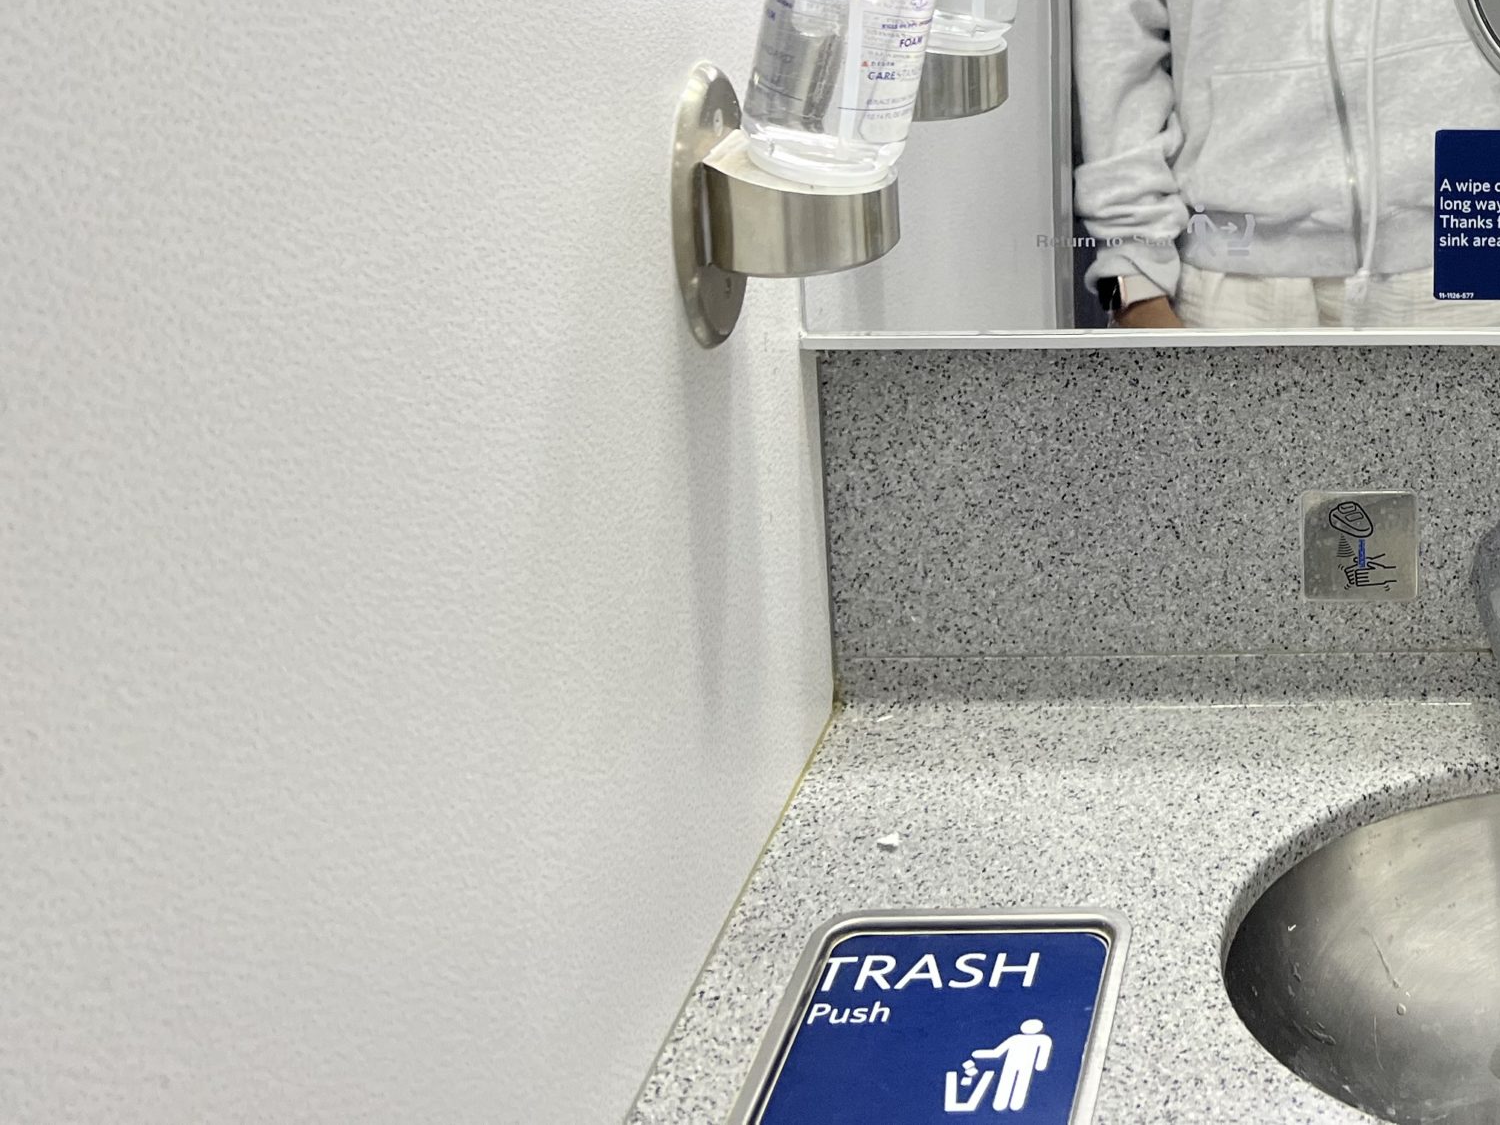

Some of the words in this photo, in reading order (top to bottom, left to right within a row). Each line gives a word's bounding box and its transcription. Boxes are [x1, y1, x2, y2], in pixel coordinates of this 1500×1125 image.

[899, 35, 924, 48] FOAM
[867, 71, 896, 81] CARE
[1440, 179, 1452, 192] A
[1456, 179, 1490, 195] wipe
[1440, 197, 1471, 213] long
[1440, 215, 1493, 229] Thanks
[1439, 233, 1469, 247] sink
[820, 952, 1041, 992] TRASH
[806, 1001, 891, 1025] Push
